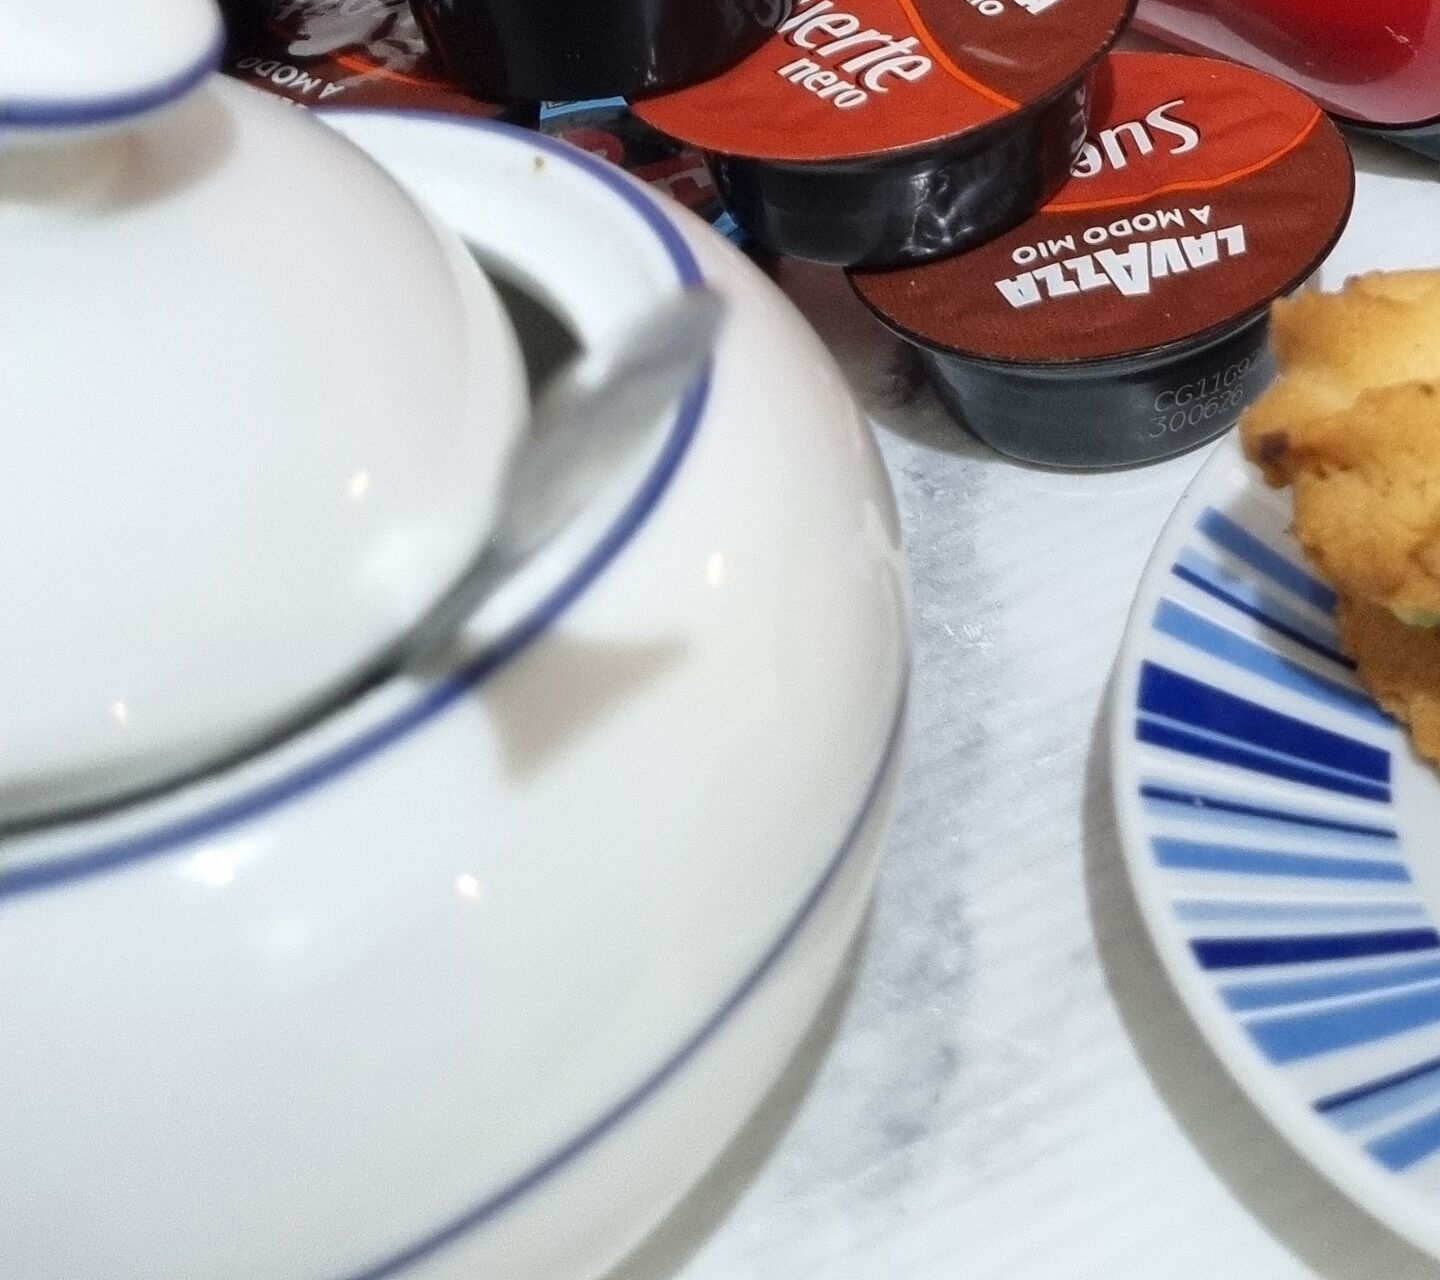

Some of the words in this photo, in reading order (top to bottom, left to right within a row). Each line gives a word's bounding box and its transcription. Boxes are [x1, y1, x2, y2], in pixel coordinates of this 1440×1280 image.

[777, 57, 868, 109] nero
[1083, 207, 1186, 245] MODO
[1188, 205, 1212, 226] A
[994, 224, 1247, 310] LAVAZZA
[1012, 234, 1077, 265] MIO
